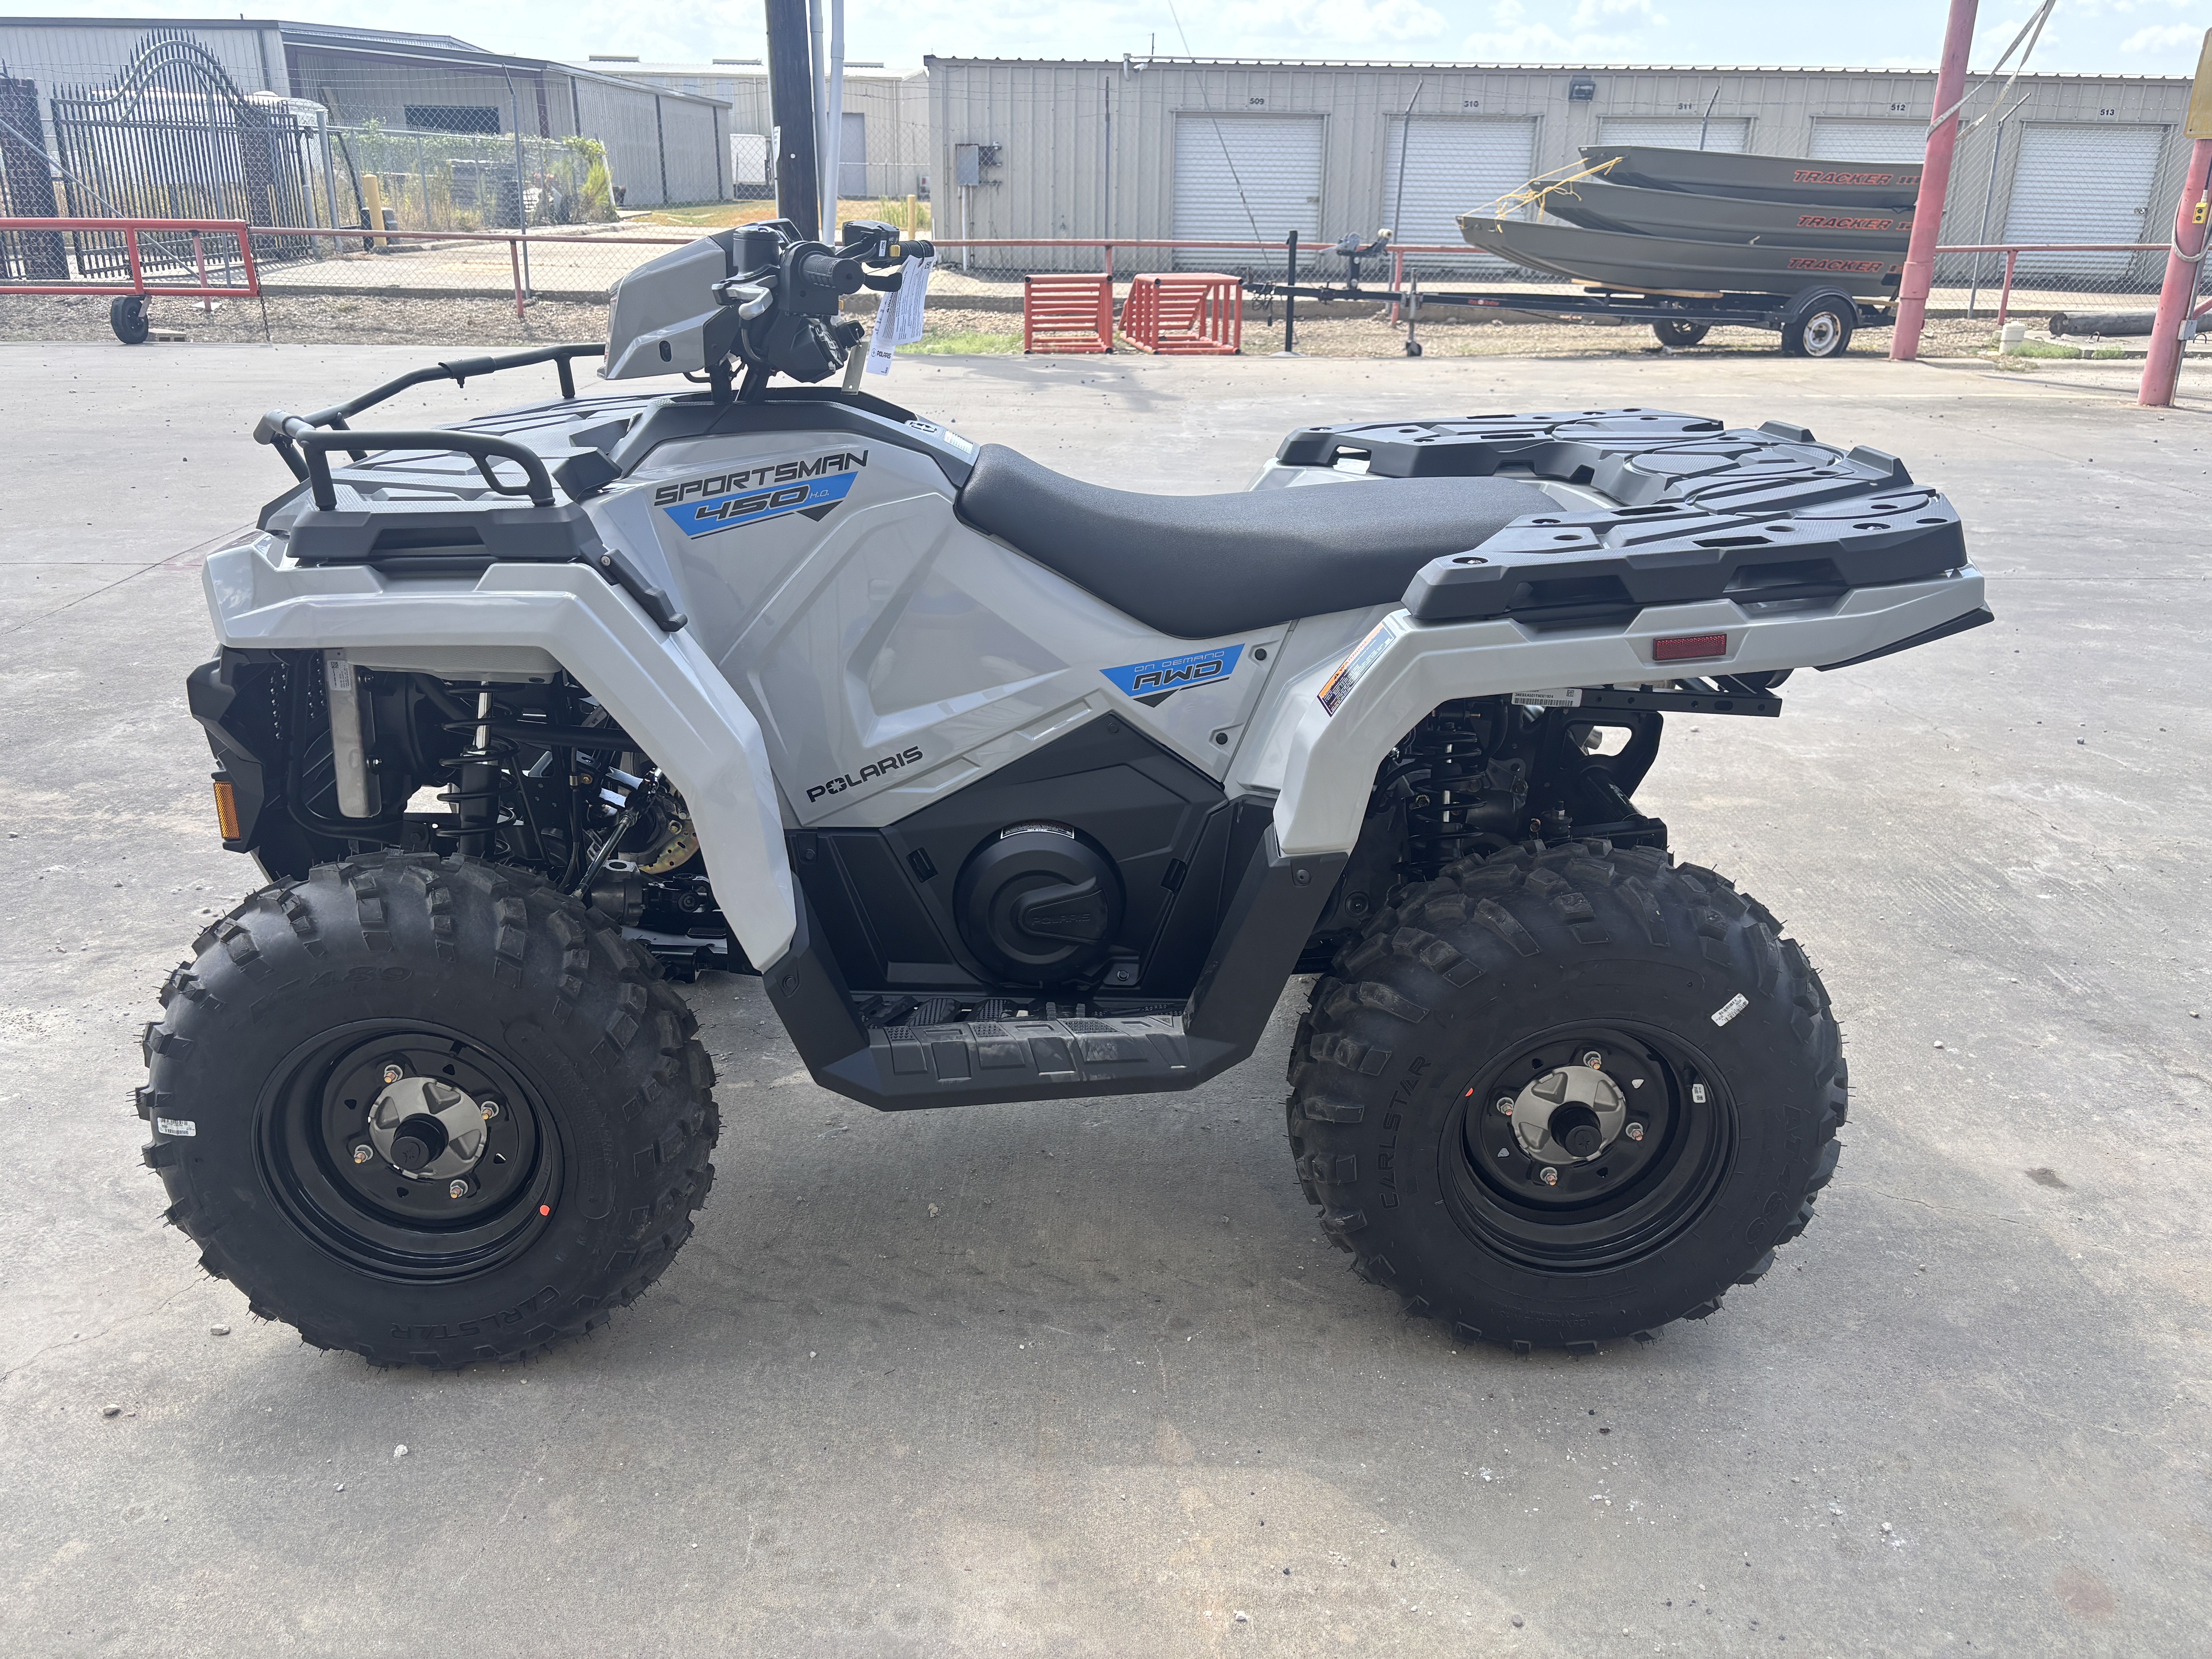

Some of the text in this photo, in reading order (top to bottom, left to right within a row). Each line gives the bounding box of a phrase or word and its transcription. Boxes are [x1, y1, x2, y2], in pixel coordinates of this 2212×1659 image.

[1793, 170, 1894, 185] TRACKER
[1796, 215, 1893, 230] TRACKER
[1787, 258, 1884, 273] TRACKER
[876, 350, 892, 359] POLARIS
[654, 450, 869, 506] SPORTSMAN
[694, 484, 830, 521] 450 H.O.
[1134, 651, 1224, 672] ON DEMAND
[1338, 640, 1368, 672] WARNING
[1132, 659, 1223, 691] AWD
[806, 745, 923, 803] POLARIS
[1376, 1054, 1432, 1211] CARLSTAR
[390, 1285, 562, 1341] CARLSTAR
